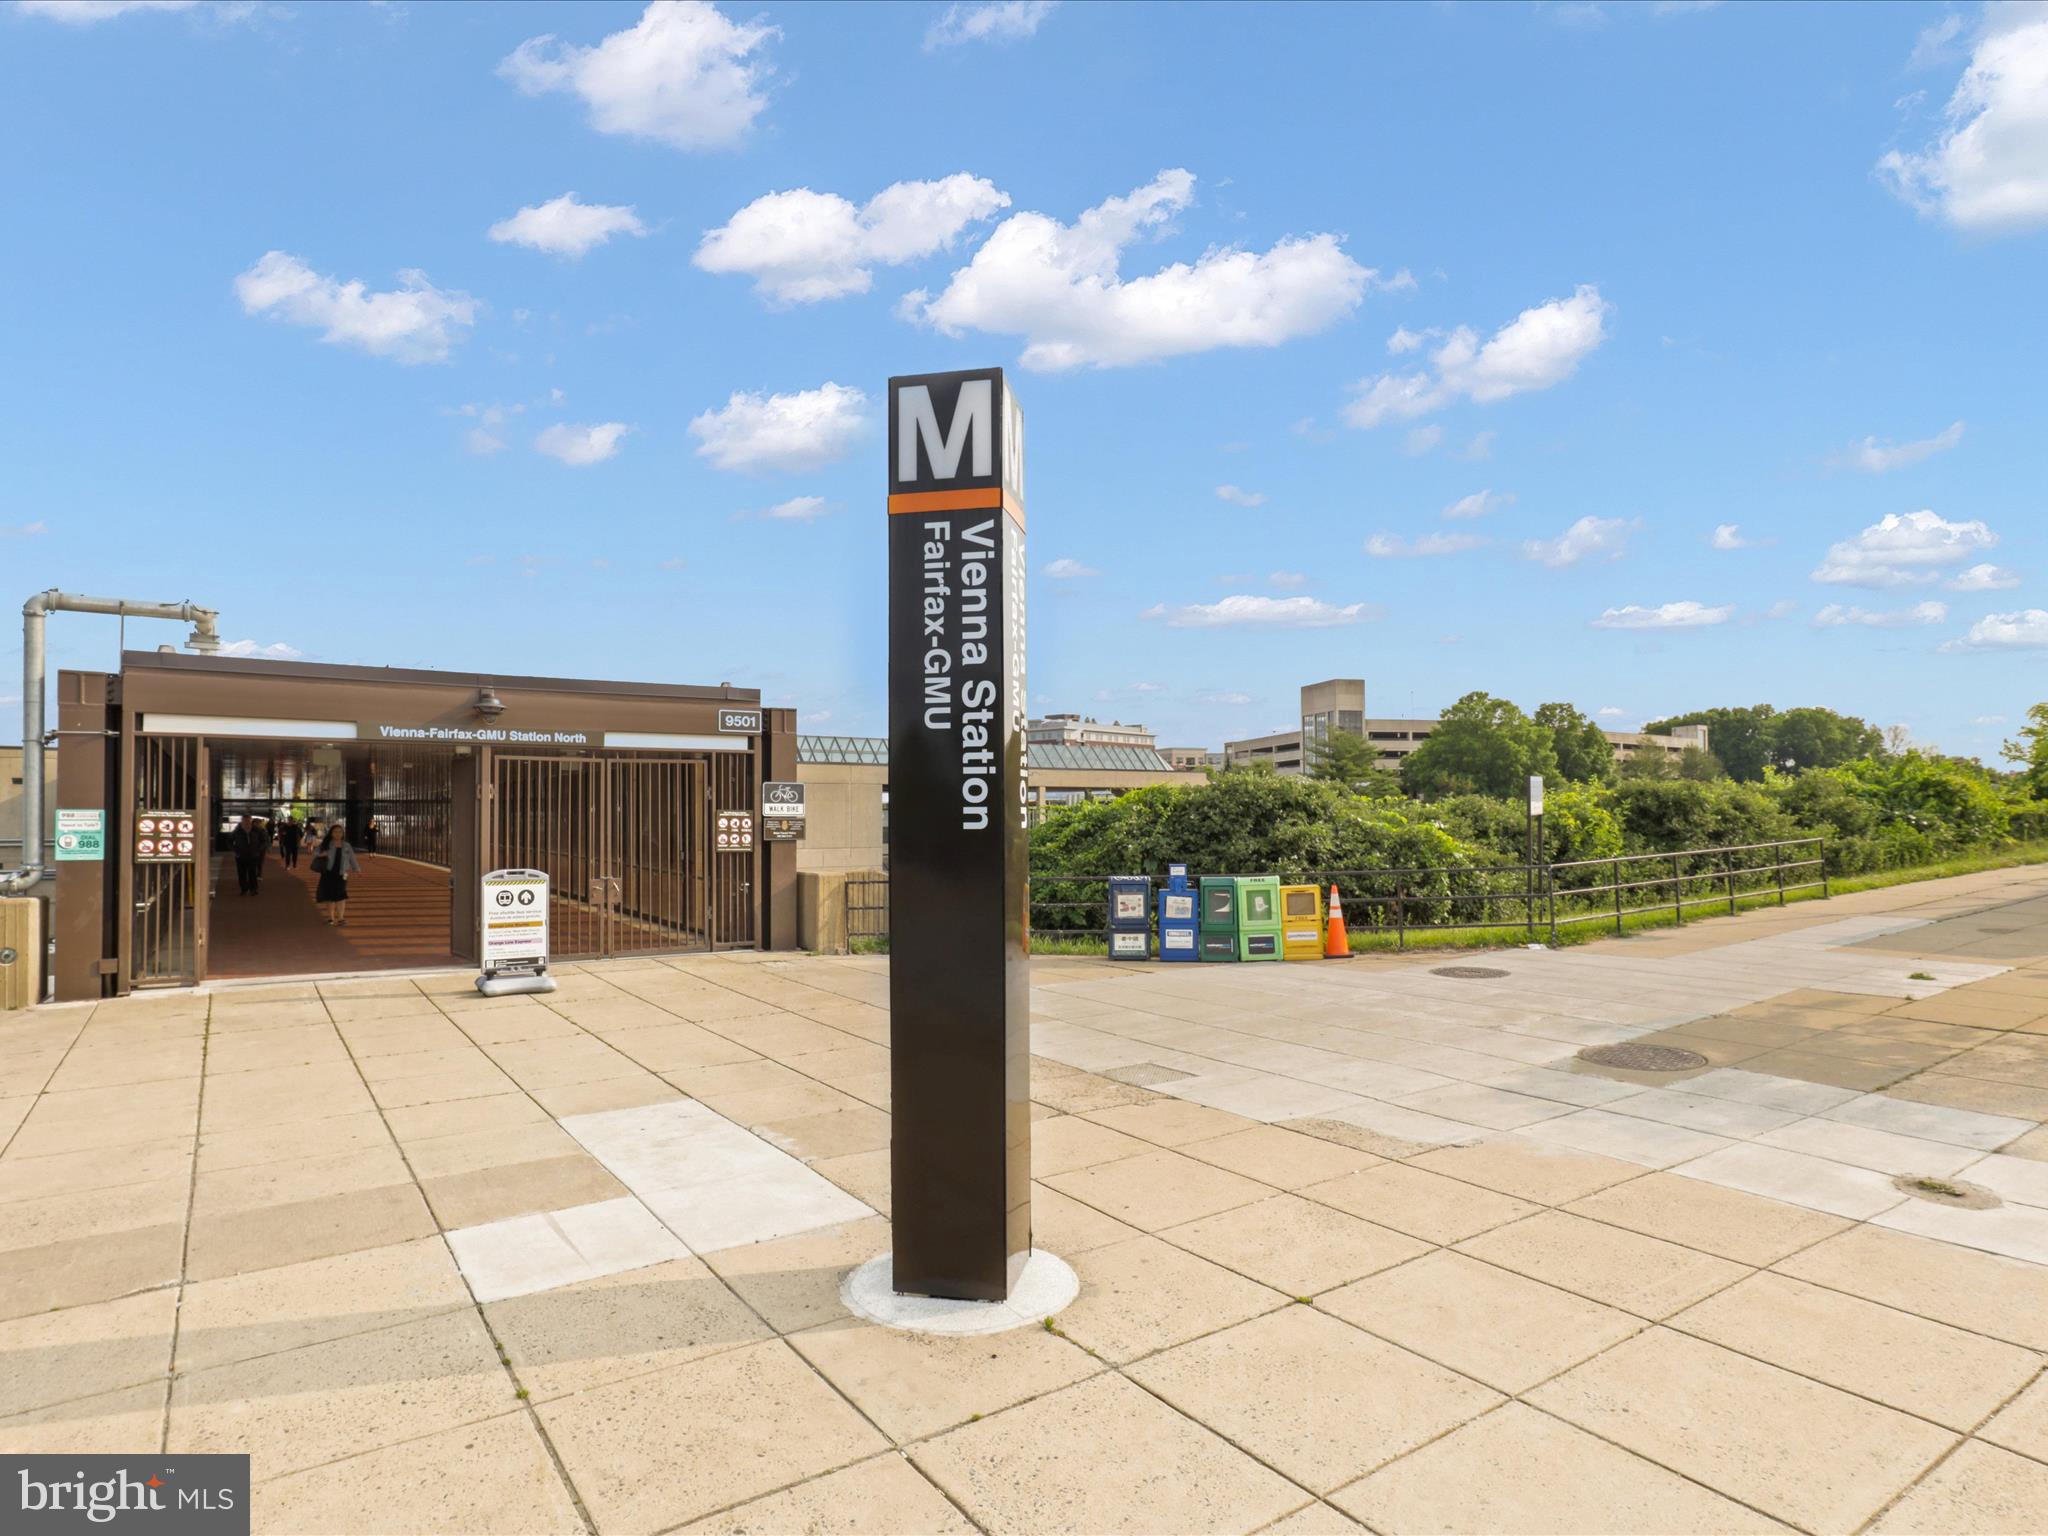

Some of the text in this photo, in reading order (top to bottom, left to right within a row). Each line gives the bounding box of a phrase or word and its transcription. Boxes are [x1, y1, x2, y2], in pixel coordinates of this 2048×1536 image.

[898, 379, 992, 483] M
[923, 520, 952, 730] Fairfax-GMU
[960, 518, 997, 831] Vienna Station
[724, 714, 756, 728] 9501
[379, 725, 587, 744] Vienna-Fairfax-GMU Station North
[768, 805, 799, 813] WALK BIKE
[78, 840, 100, 849] 988
